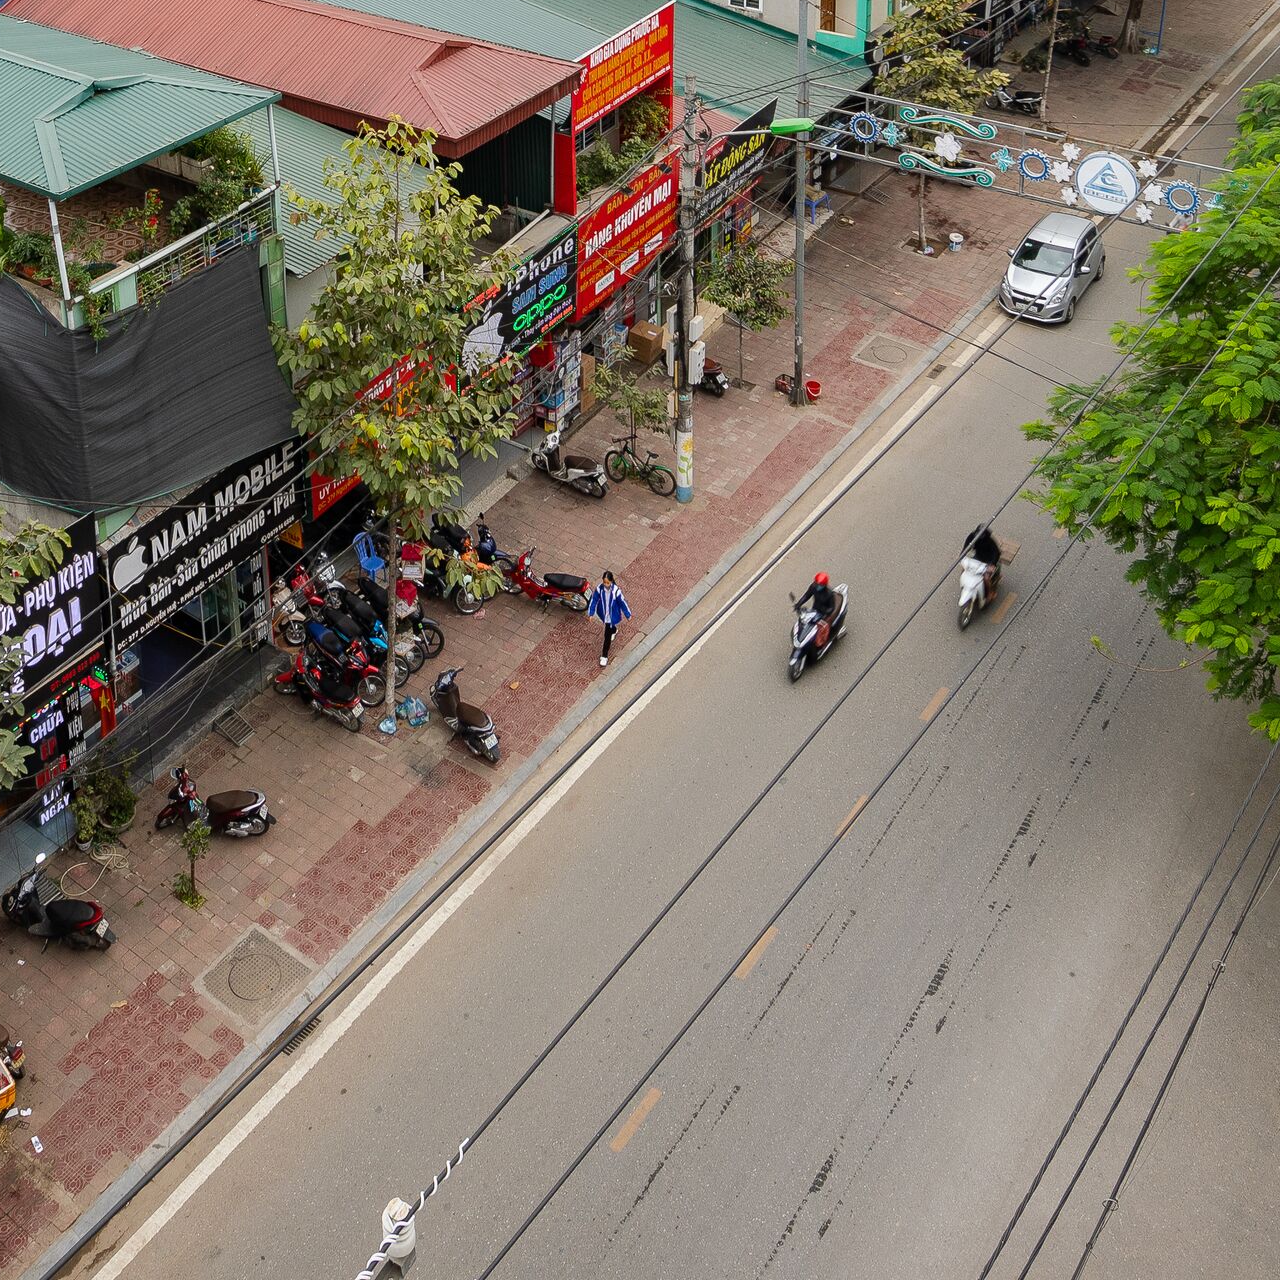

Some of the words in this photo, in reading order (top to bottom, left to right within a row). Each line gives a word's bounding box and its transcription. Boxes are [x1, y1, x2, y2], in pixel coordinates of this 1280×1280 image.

[705, 159, 721, 190] ẤT
[585, 223, 613, 259] HÀNG
[614, 191, 652, 236] KHUYẾN
[653, 178, 672, 208] MẠI
[149, 502, 208, 567] NAM
[213, 441, 295, 522] MOBILE
[273, 482, 296, 517] iPad
[319, 484, 331, 500] UY
[24, 575, 56, 617] PHỤ
[58, 551, 95, 595] KIỆN
[30, 709, 65, 745] CHỮA
